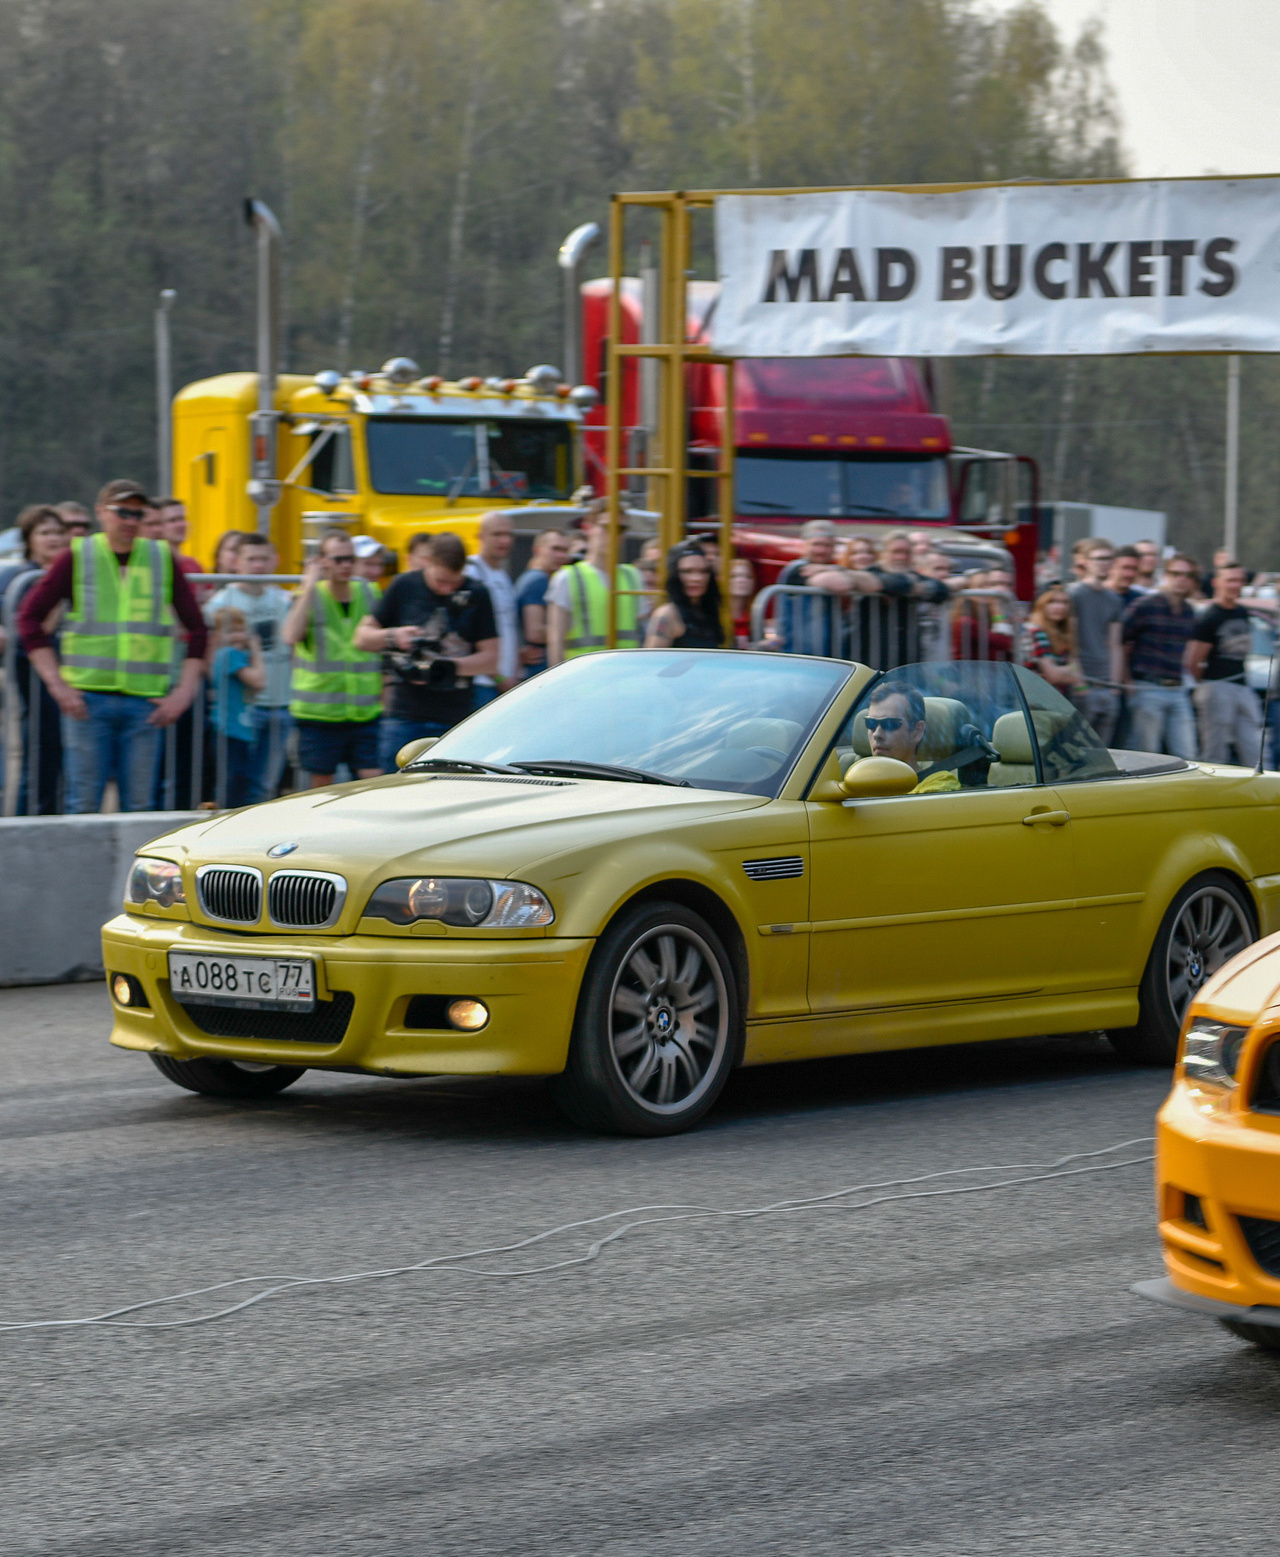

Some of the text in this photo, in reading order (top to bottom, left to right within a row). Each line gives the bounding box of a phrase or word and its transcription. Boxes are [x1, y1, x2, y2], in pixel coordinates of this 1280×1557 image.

[763, 237, 1240, 302] MAD BUCKETS
[278, 964, 304, 988] 77
[279, 987, 299, 997] RUS
